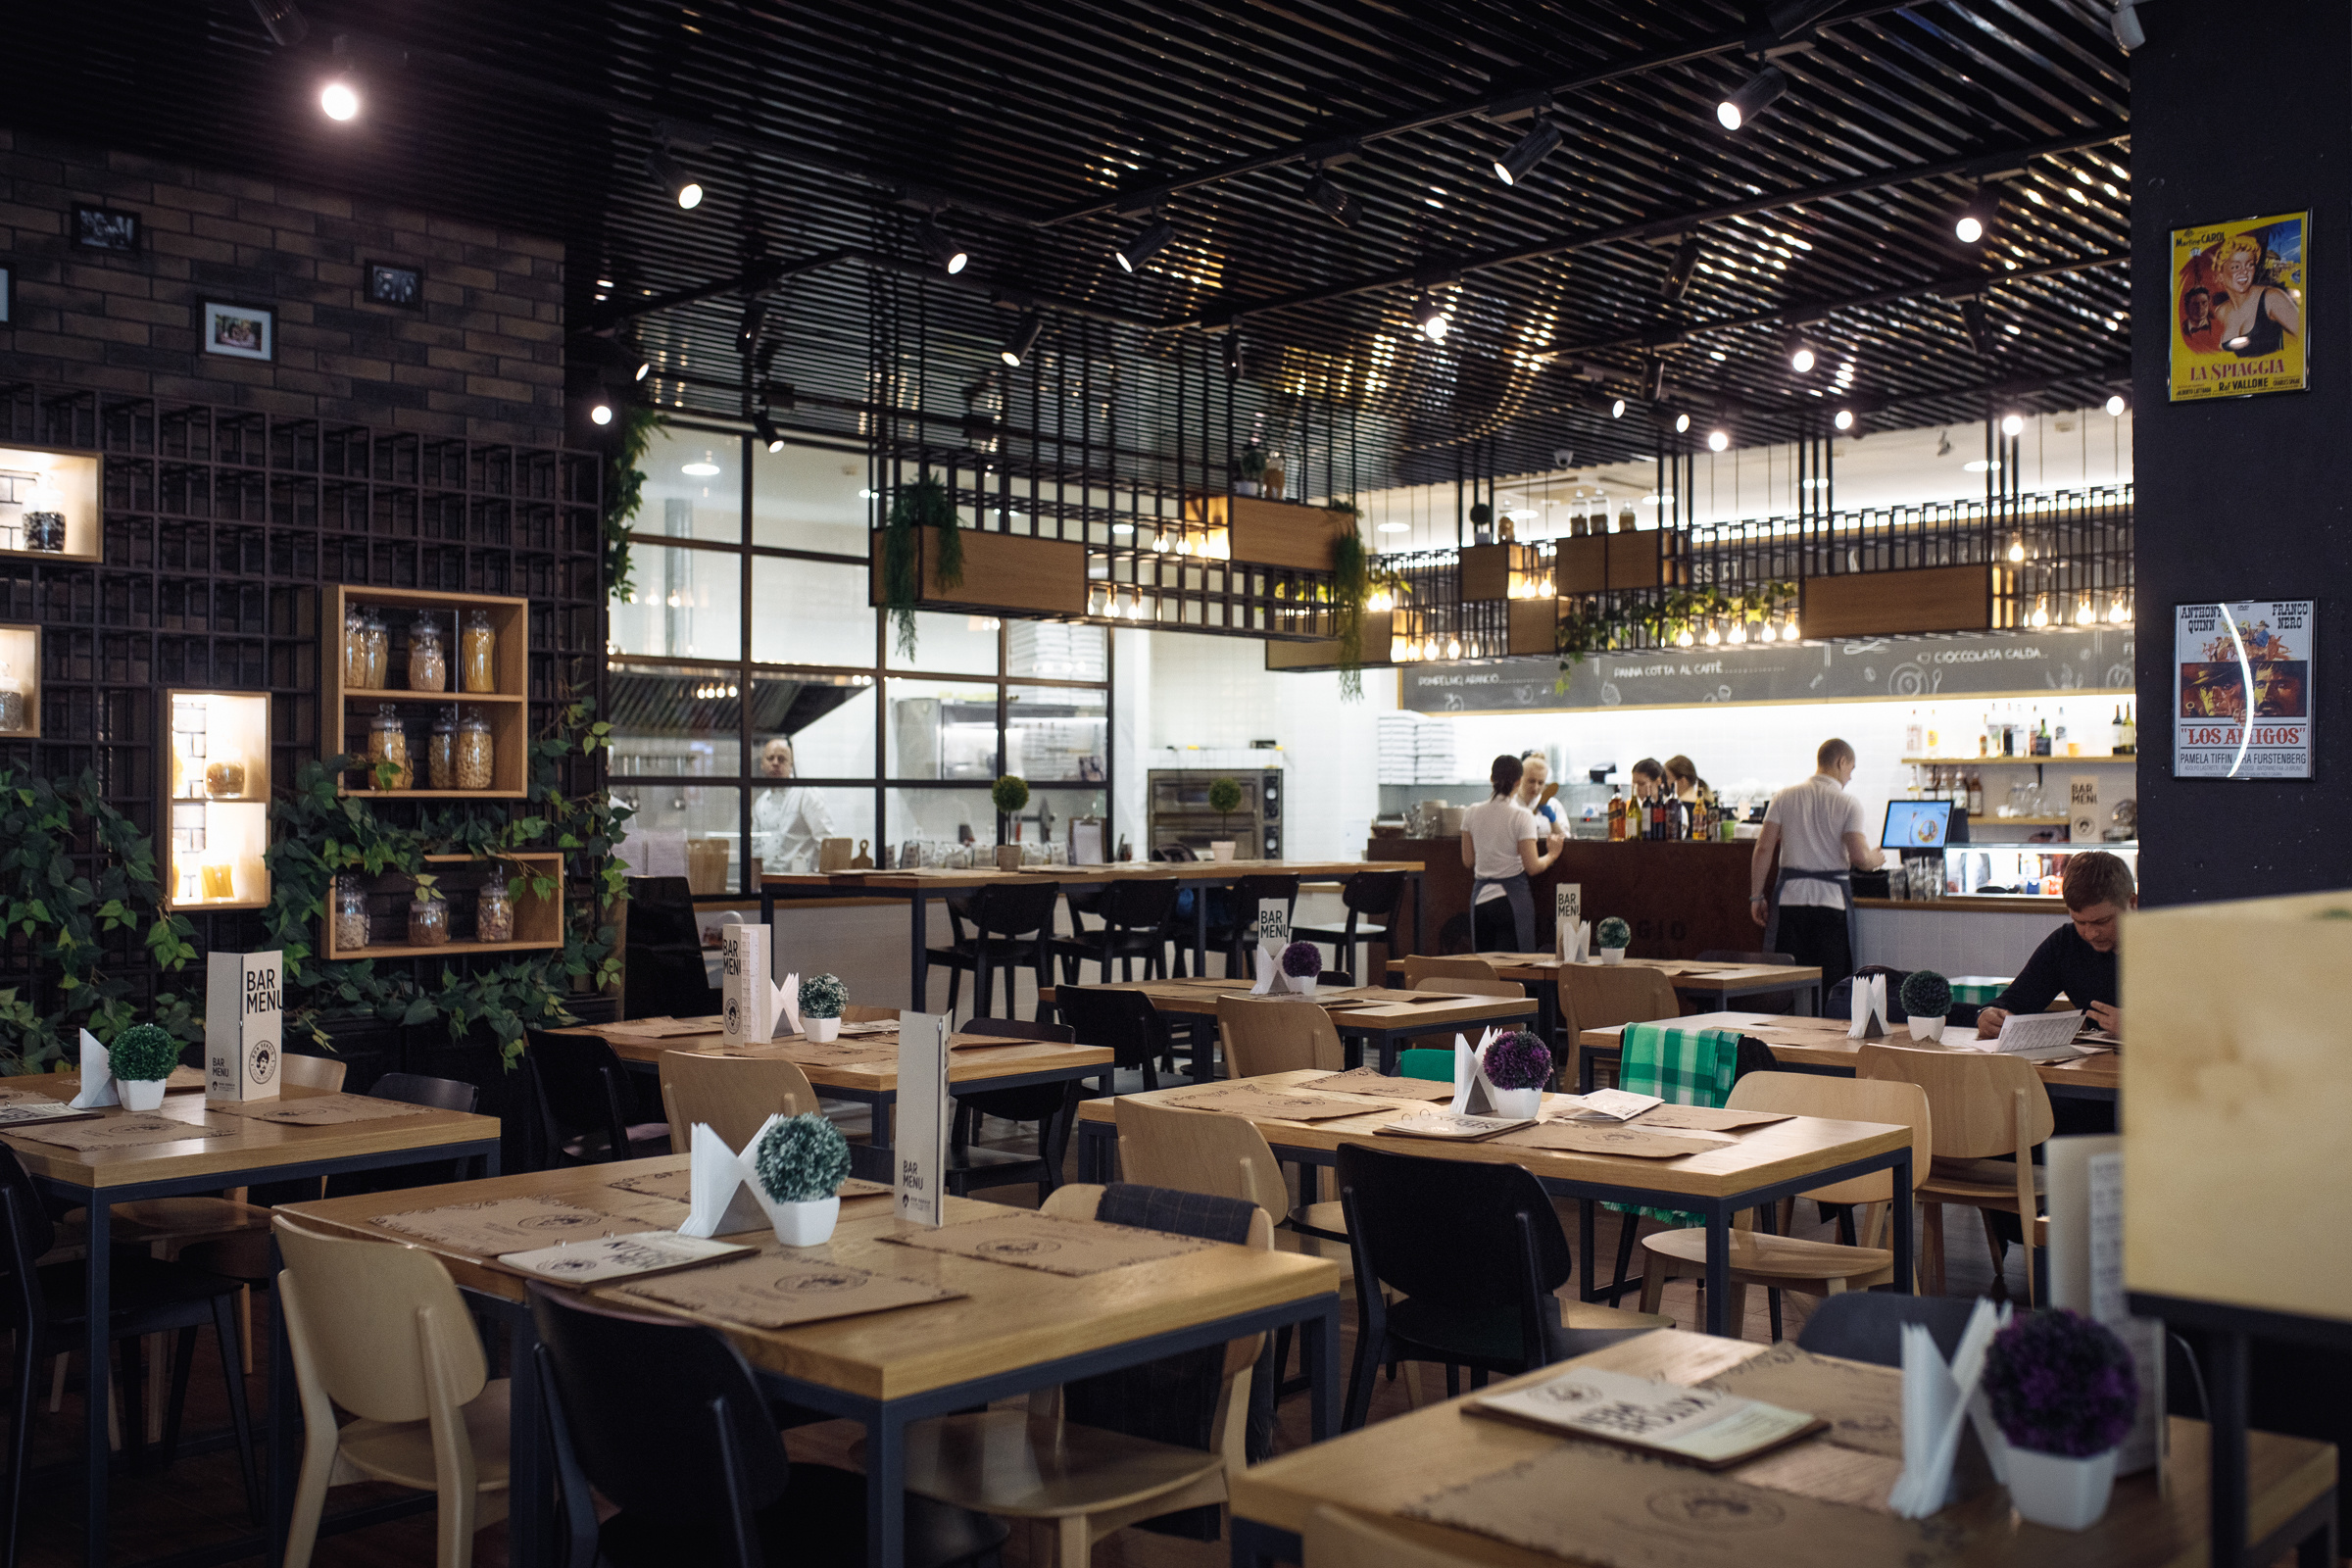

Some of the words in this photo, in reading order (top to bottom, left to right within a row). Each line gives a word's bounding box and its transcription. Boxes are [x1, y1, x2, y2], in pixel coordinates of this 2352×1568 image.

[2201, 231, 2225, 243] CAROL
[2190, 367, 2207, 380] LA
[2210, 359, 2284, 380] SPIAGGIA
[2232, 377, 2269, 390] VALLONE
[2181, 606, 2222, 618] ANTHONY
[2272, 603, 2308, 615] FRANCO
[2188, 619, 2215, 634] QUINN
[2278, 616, 2302, 629] NERO
[1934, 649, 2002, 663] CIOCCOLATA
[1613, 666, 1643, 678] PANNA
[1644, 663, 1676, 677] COTTA
[1679, 663, 1692, 676] AL
[2180, 753, 2209, 763] PAMELA
[2211, 752, 2232, 763] TIFFIN
[2253, 752, 2306, 764] FURSTENBERG
[2072, 784, 2093, 794] BAR
[1558, 893, 1577, 906] BAR
[1260, 909, 1283, 924] BAR
[723, 939, 738, 957] BAR
[246, 968, 275, 992] BAR
[212, 1056, 225, 1068] BAR
[212, 1066, 229, 1078] MENU
[903, 1159, 918, 1175] BAR
[903, 1173, 923, 1191] MENU
